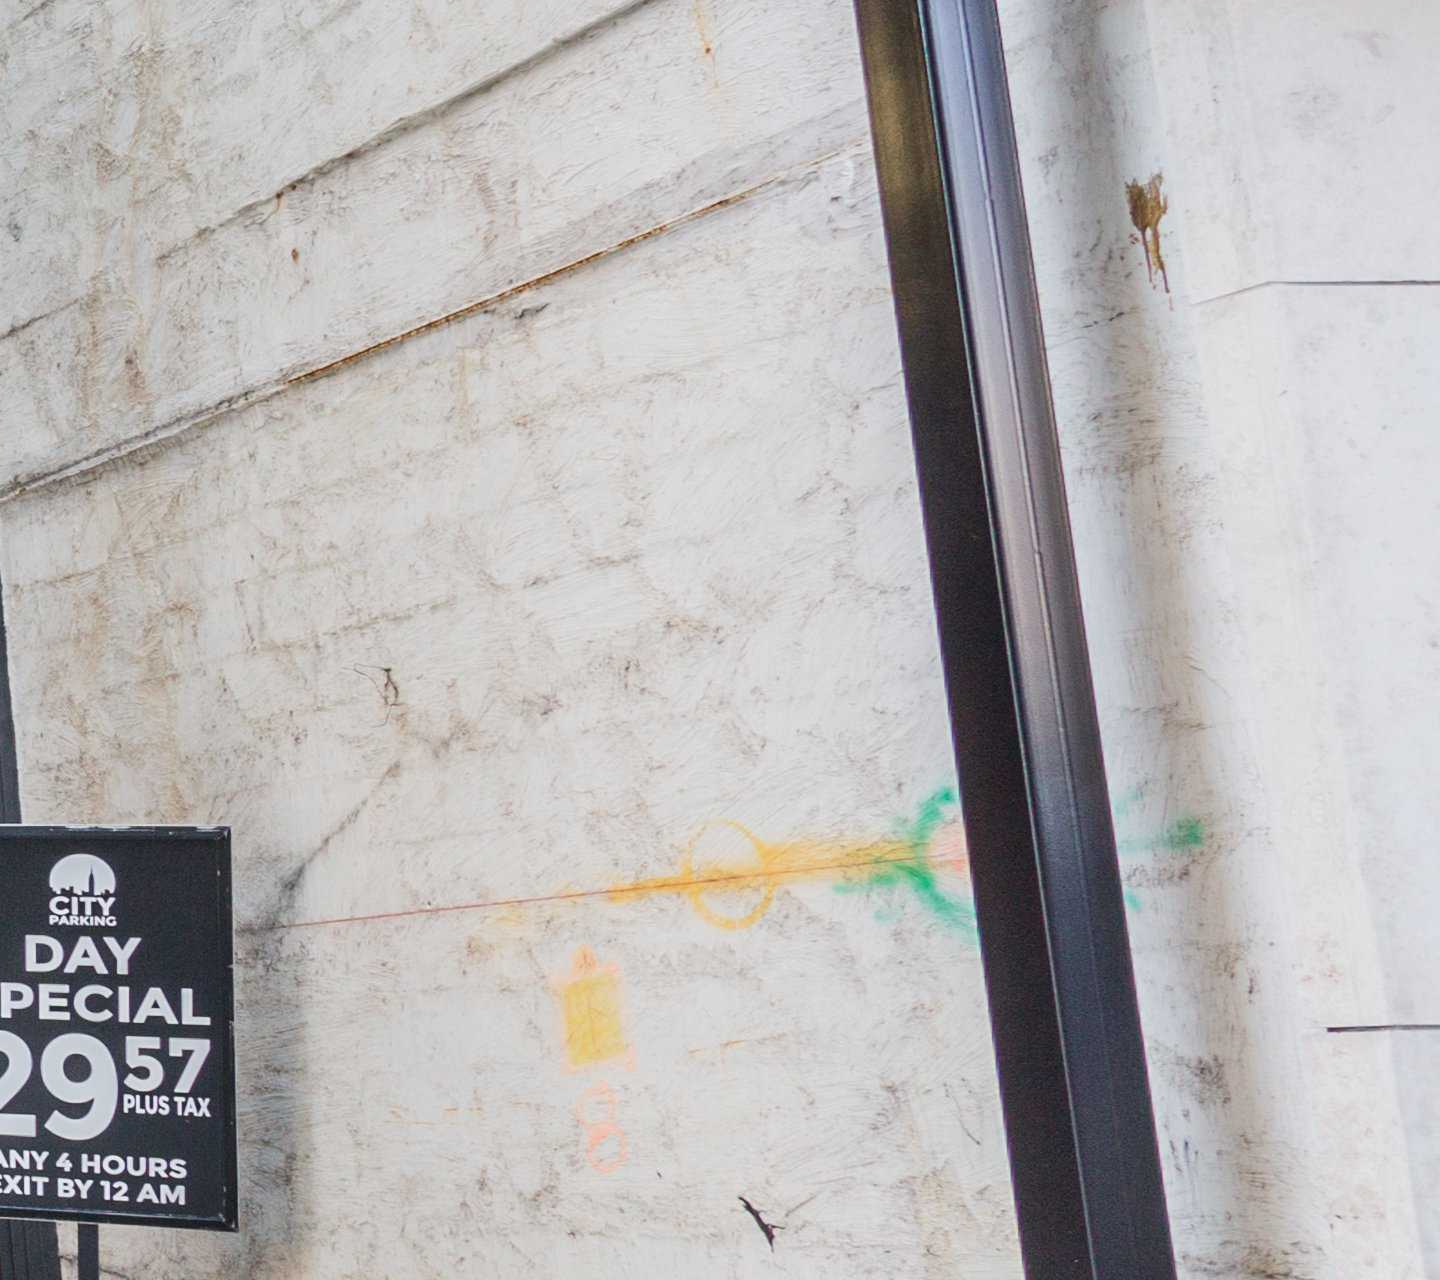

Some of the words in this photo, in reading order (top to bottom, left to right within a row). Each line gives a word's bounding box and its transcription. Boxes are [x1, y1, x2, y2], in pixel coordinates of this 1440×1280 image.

[49, 896, 116, 916] CITY
[49, 915, 117, 926] PARKING
[25, 934, 141, 974] DAY
[124, 1036, 211, 1093] 57
[123, 1094, 170, 1115] PLUS
[173, 1096, 211, 1117] TAX
[56, 1153, 73, 1172] 4
[81, 1154, 188, 1179] HOURS
[57, 1178, 94, 1199] BY
[100, 1180, 129, 1202] 12
[136, 1183, 186, 1205] AM
